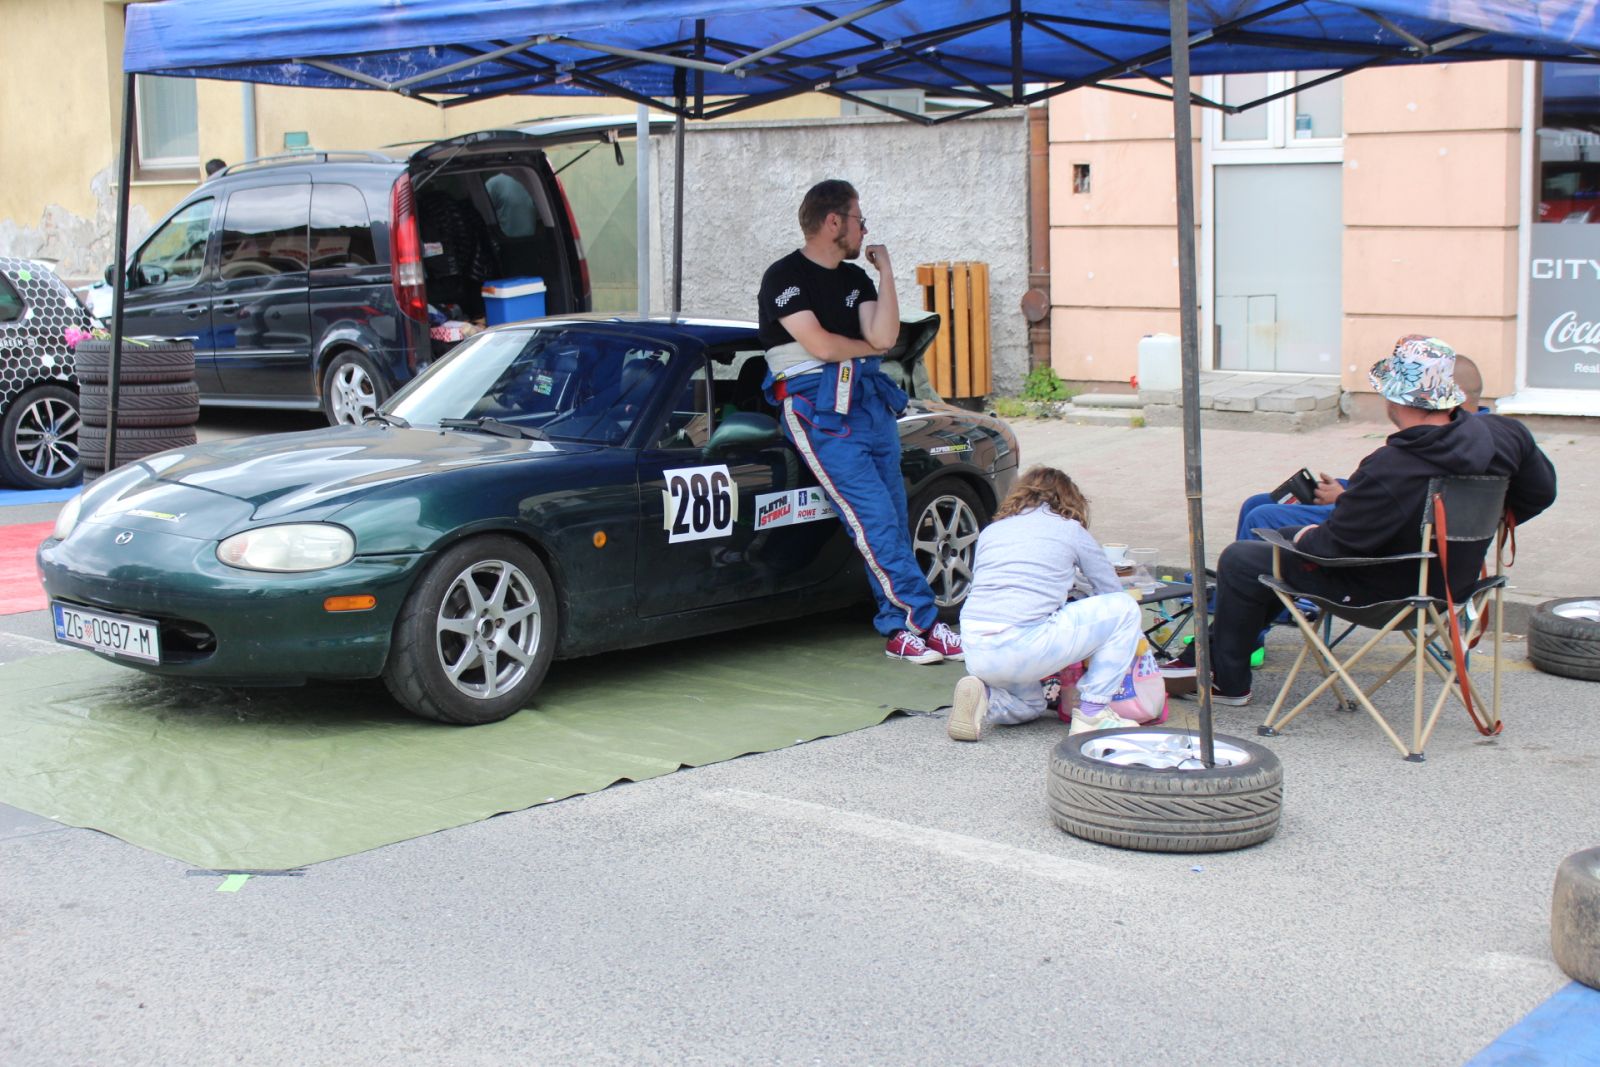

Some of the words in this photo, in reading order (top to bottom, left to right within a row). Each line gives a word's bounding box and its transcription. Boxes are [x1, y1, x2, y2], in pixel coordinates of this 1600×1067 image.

[671, 471, 730, 535] 286
[798, 508, 816, 518] ROWE
[64, 611, 83, 639] ZG
